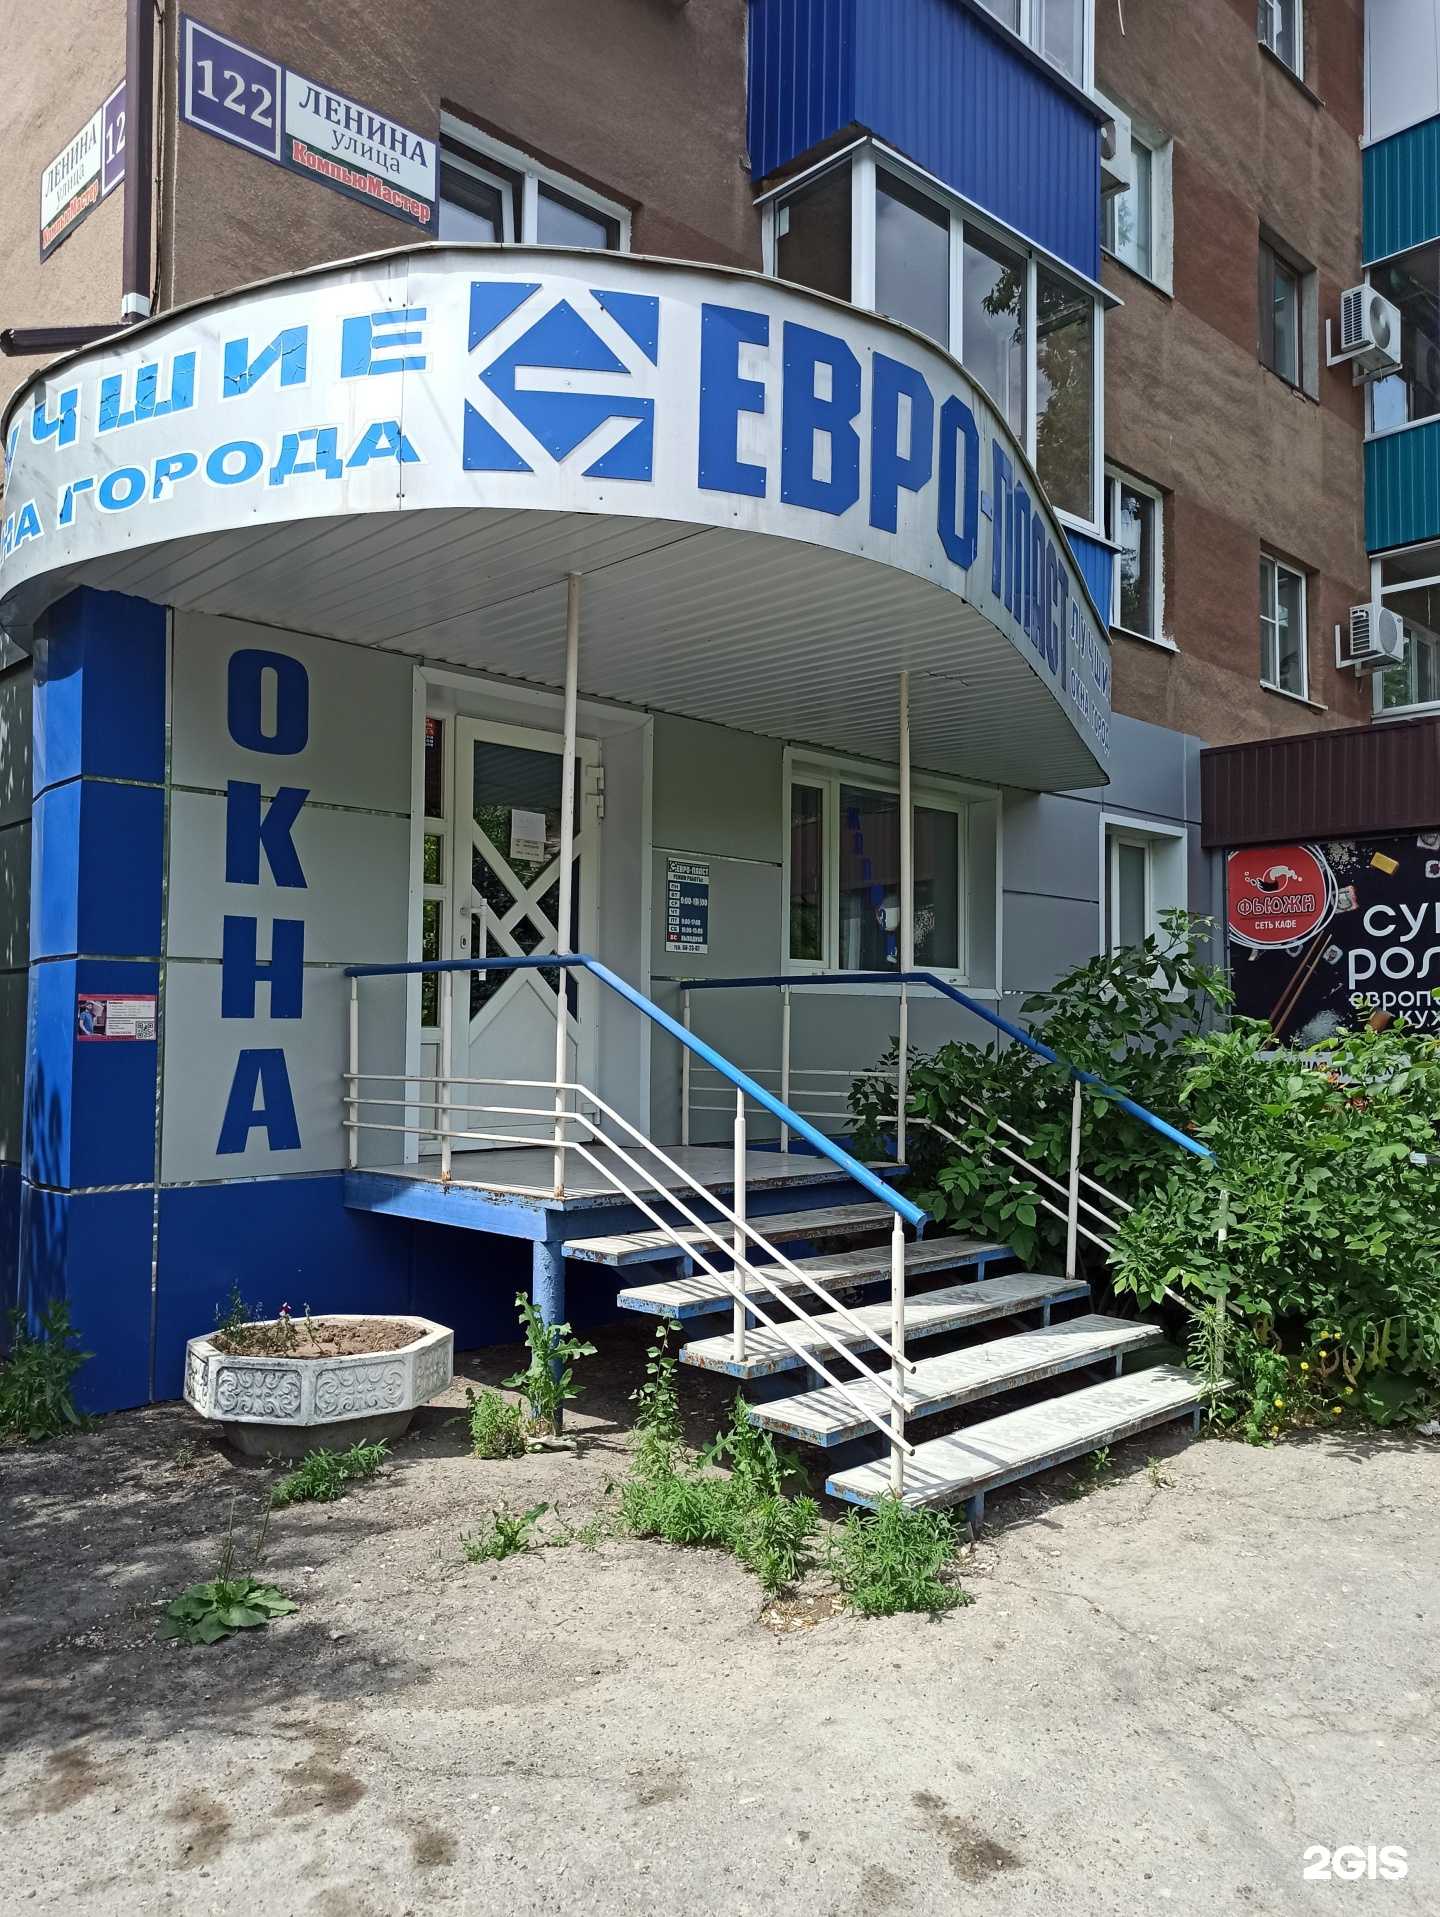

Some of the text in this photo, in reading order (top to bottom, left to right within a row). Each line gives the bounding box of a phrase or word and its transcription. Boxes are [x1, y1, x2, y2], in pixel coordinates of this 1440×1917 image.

[196, 59, 273, 128] 122
[298, 86, 428, 168] ЛЕНИНА
[45, 123, 97, 198] ЛЕНИНА
[56, 163, 86, 211] улица
[292, 138, 431, 224] КомпьюМастер
[331, 130, 401, 174] улица
[57, 419, 422, 527] ГОРОДА
[698, 302, 1069, 692] ЕВРО-ПЛАСТ
[1070, 597, 1112, 703] ЛУЧШИ
[215, 648, 310, 1155] ОКНА
[1237, 894, 1316, 916] ФЬЮЖН
[1255, 920, 1297, 930] СЕТЬ КАФЕ
[1363, 902, 1440, 942] су
